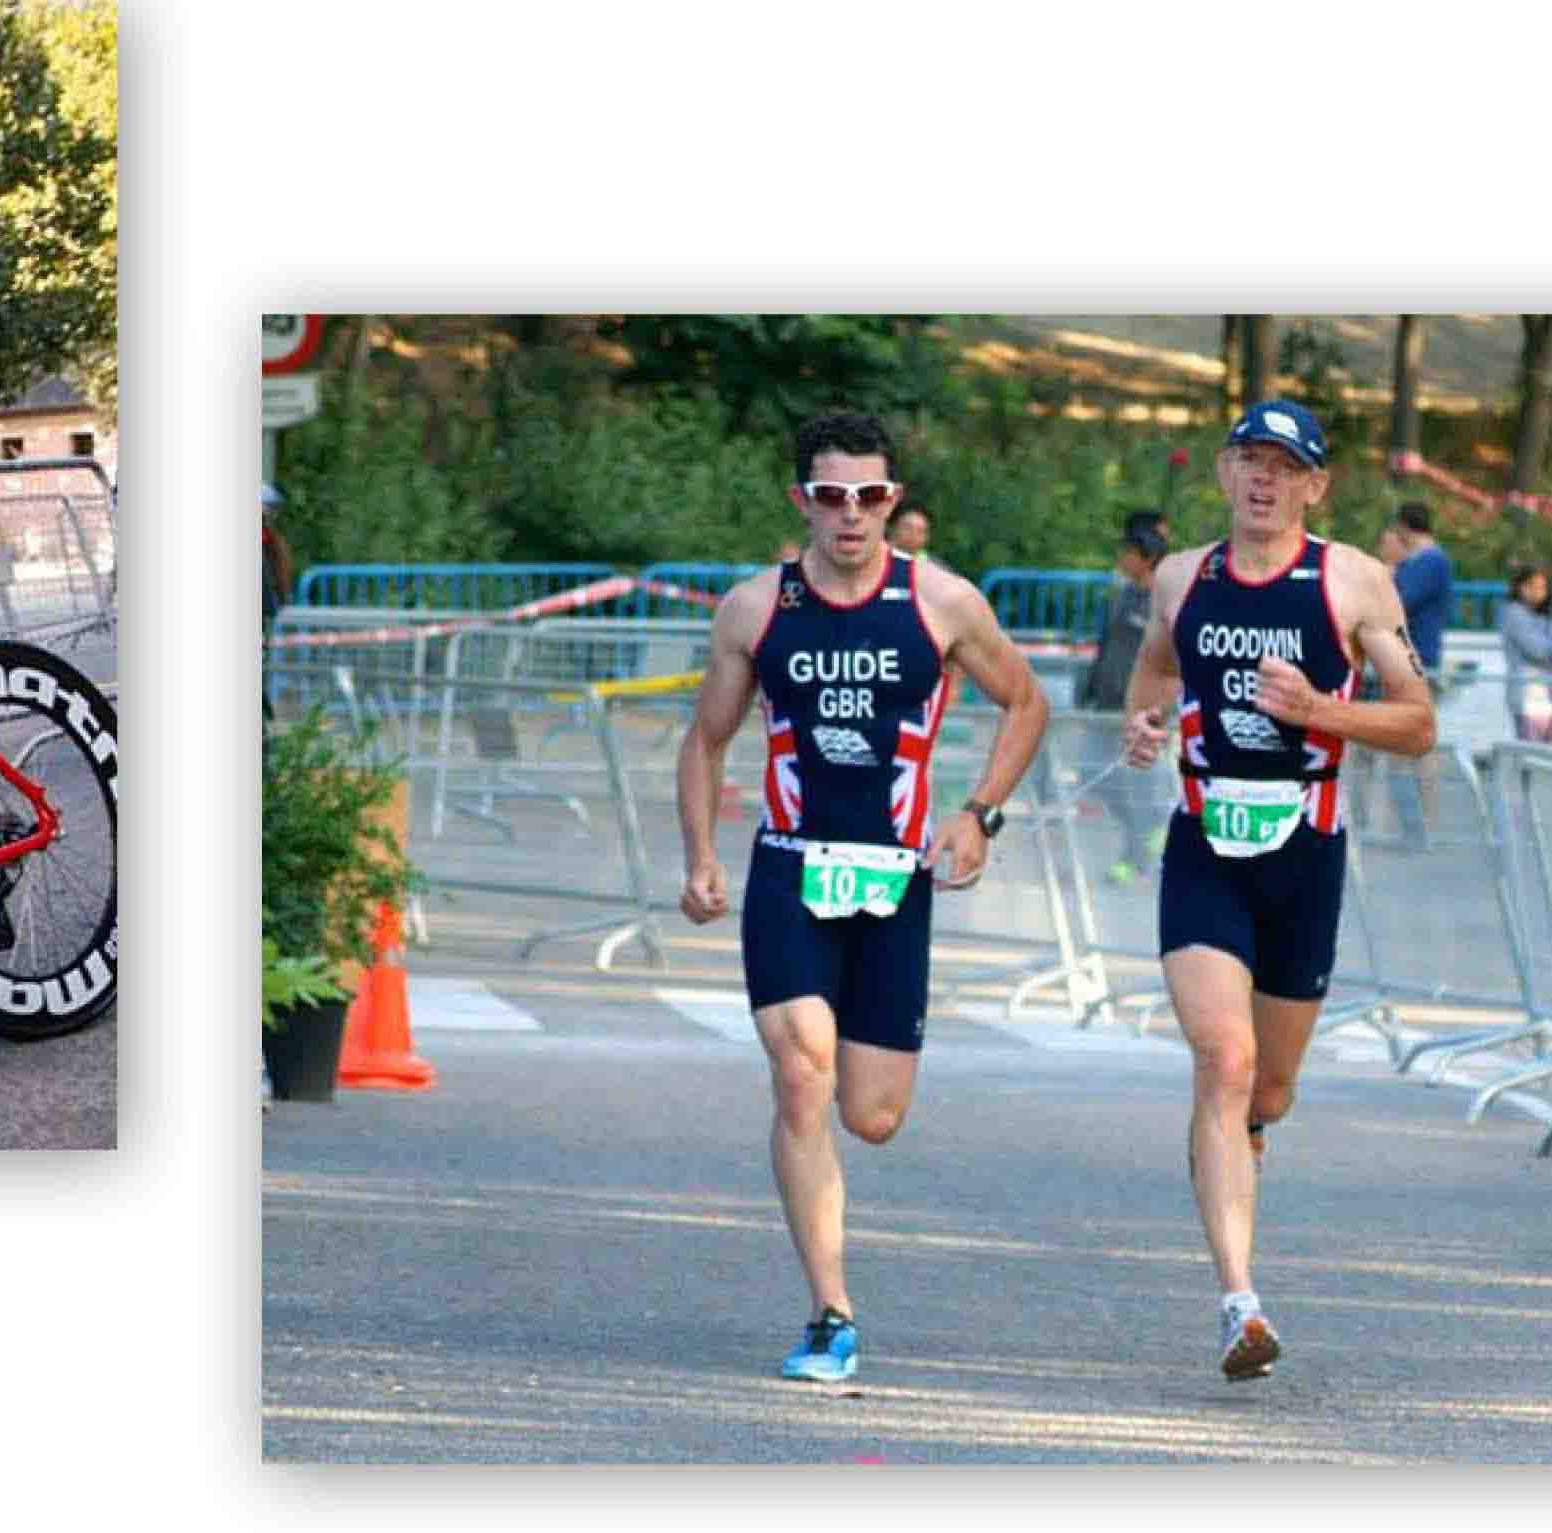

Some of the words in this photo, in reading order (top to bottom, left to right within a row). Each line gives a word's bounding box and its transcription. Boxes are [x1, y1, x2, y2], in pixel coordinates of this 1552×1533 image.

[1198, 624, 1304, 661] GOODWIN
[788, 649, 902, 683] GUIDE
[1223, 668, 1258, 702] GB
[819, 688, 875, 719] GBR
[1214, 804, 1250, 839] 10
[819, 866, 857, 903] 10
